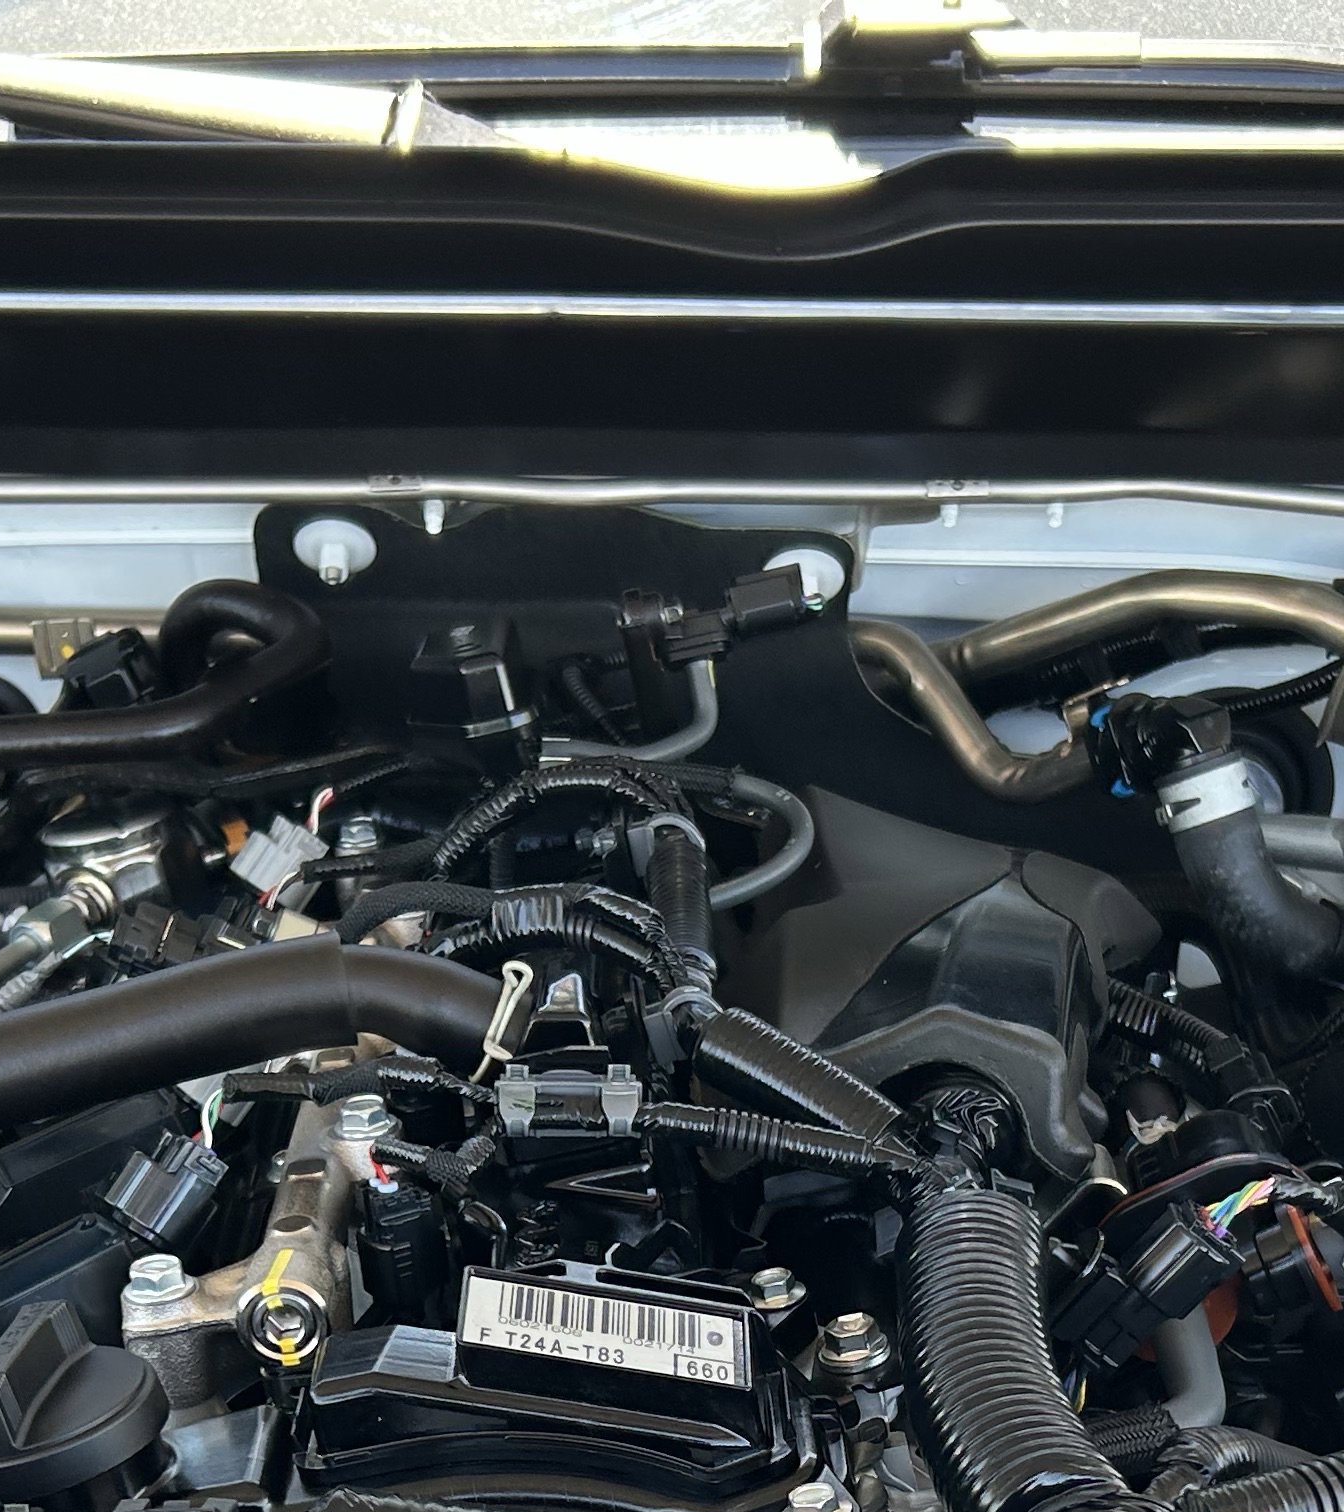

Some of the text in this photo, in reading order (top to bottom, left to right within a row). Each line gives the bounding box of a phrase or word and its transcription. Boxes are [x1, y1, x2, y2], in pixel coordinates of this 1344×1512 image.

[480, 1326, 626, 1365] F T24A-T83
[686, 1360, 730, 1382] 660
